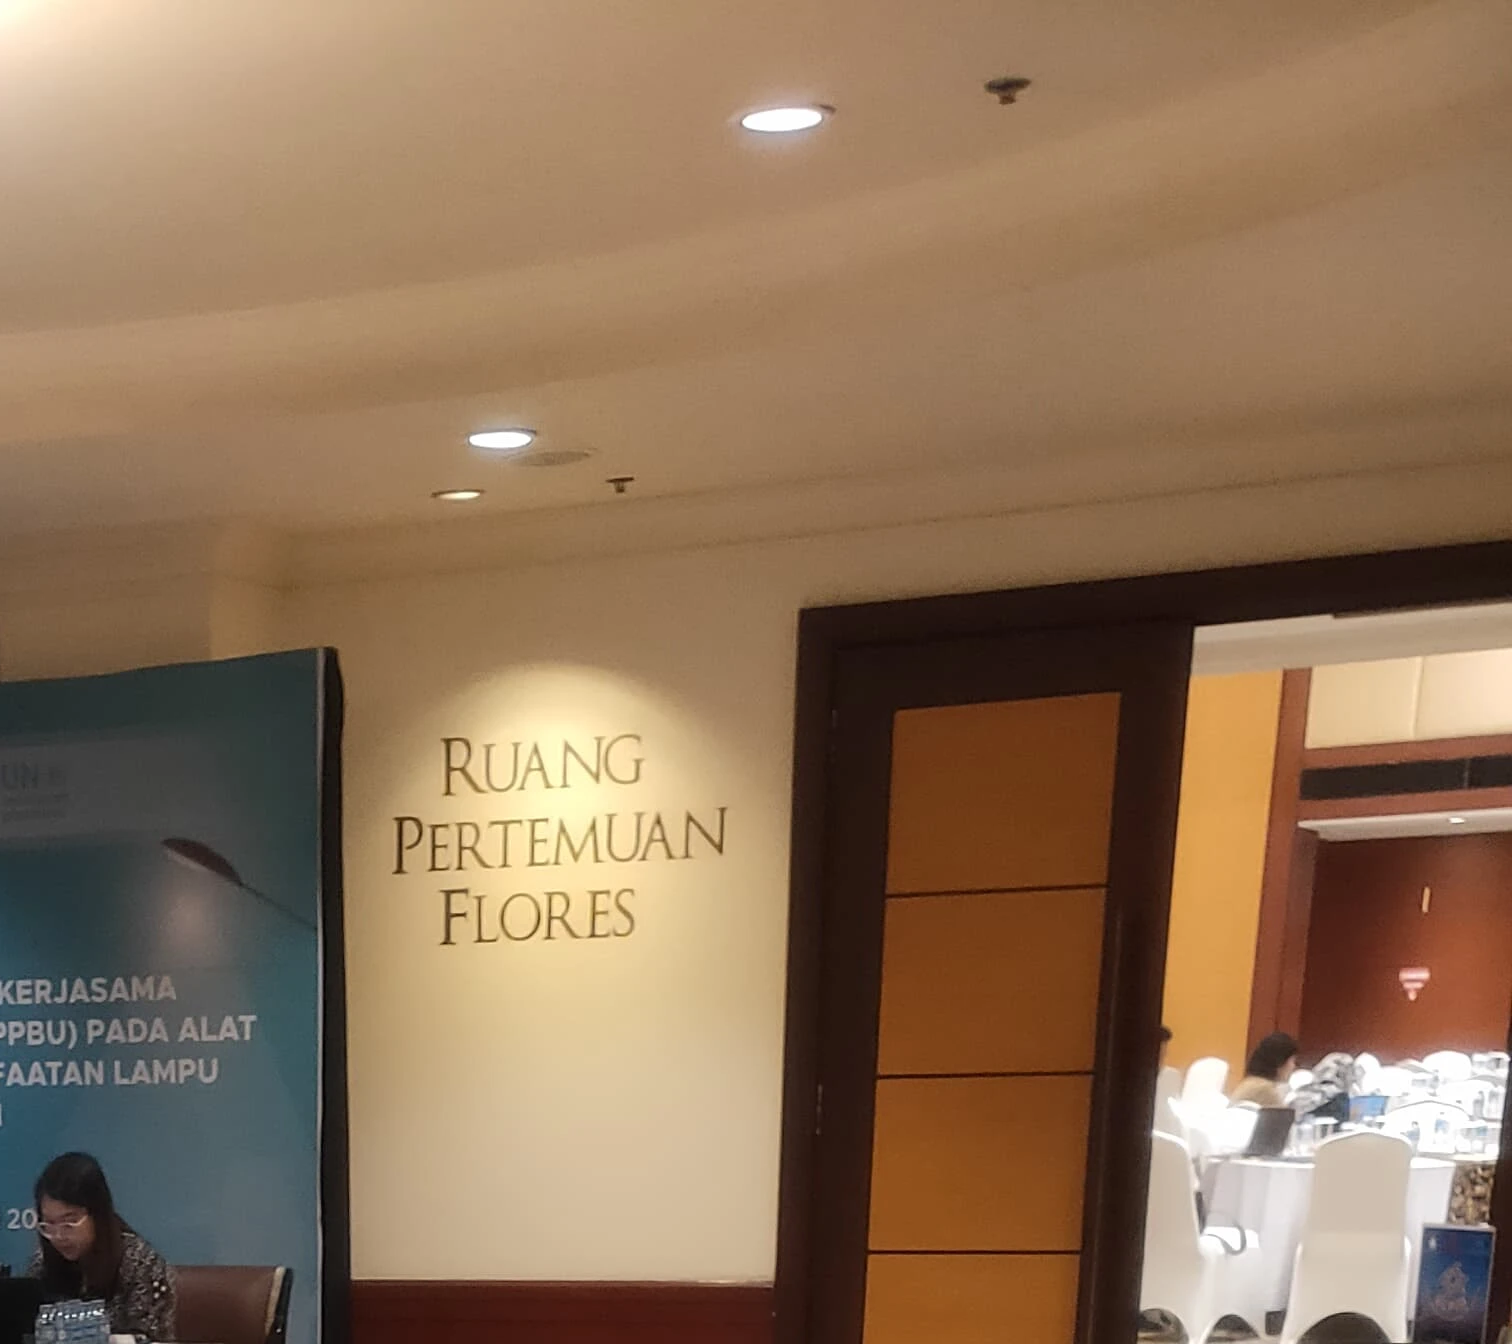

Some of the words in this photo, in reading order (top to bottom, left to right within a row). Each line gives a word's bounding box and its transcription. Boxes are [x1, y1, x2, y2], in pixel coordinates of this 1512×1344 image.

[441, 734, 645, 796] RUANG
[392, 807, 727, 875] PERTEMUAN
[438, 887, 635, 945] FLORES
[87, 1018, 168, 1044] PADA
[177, 1015, 257, 1042] ALAT
[113, 1058, 219, 1085] LAMPU
[8, 1207, 38, 1229] 20
